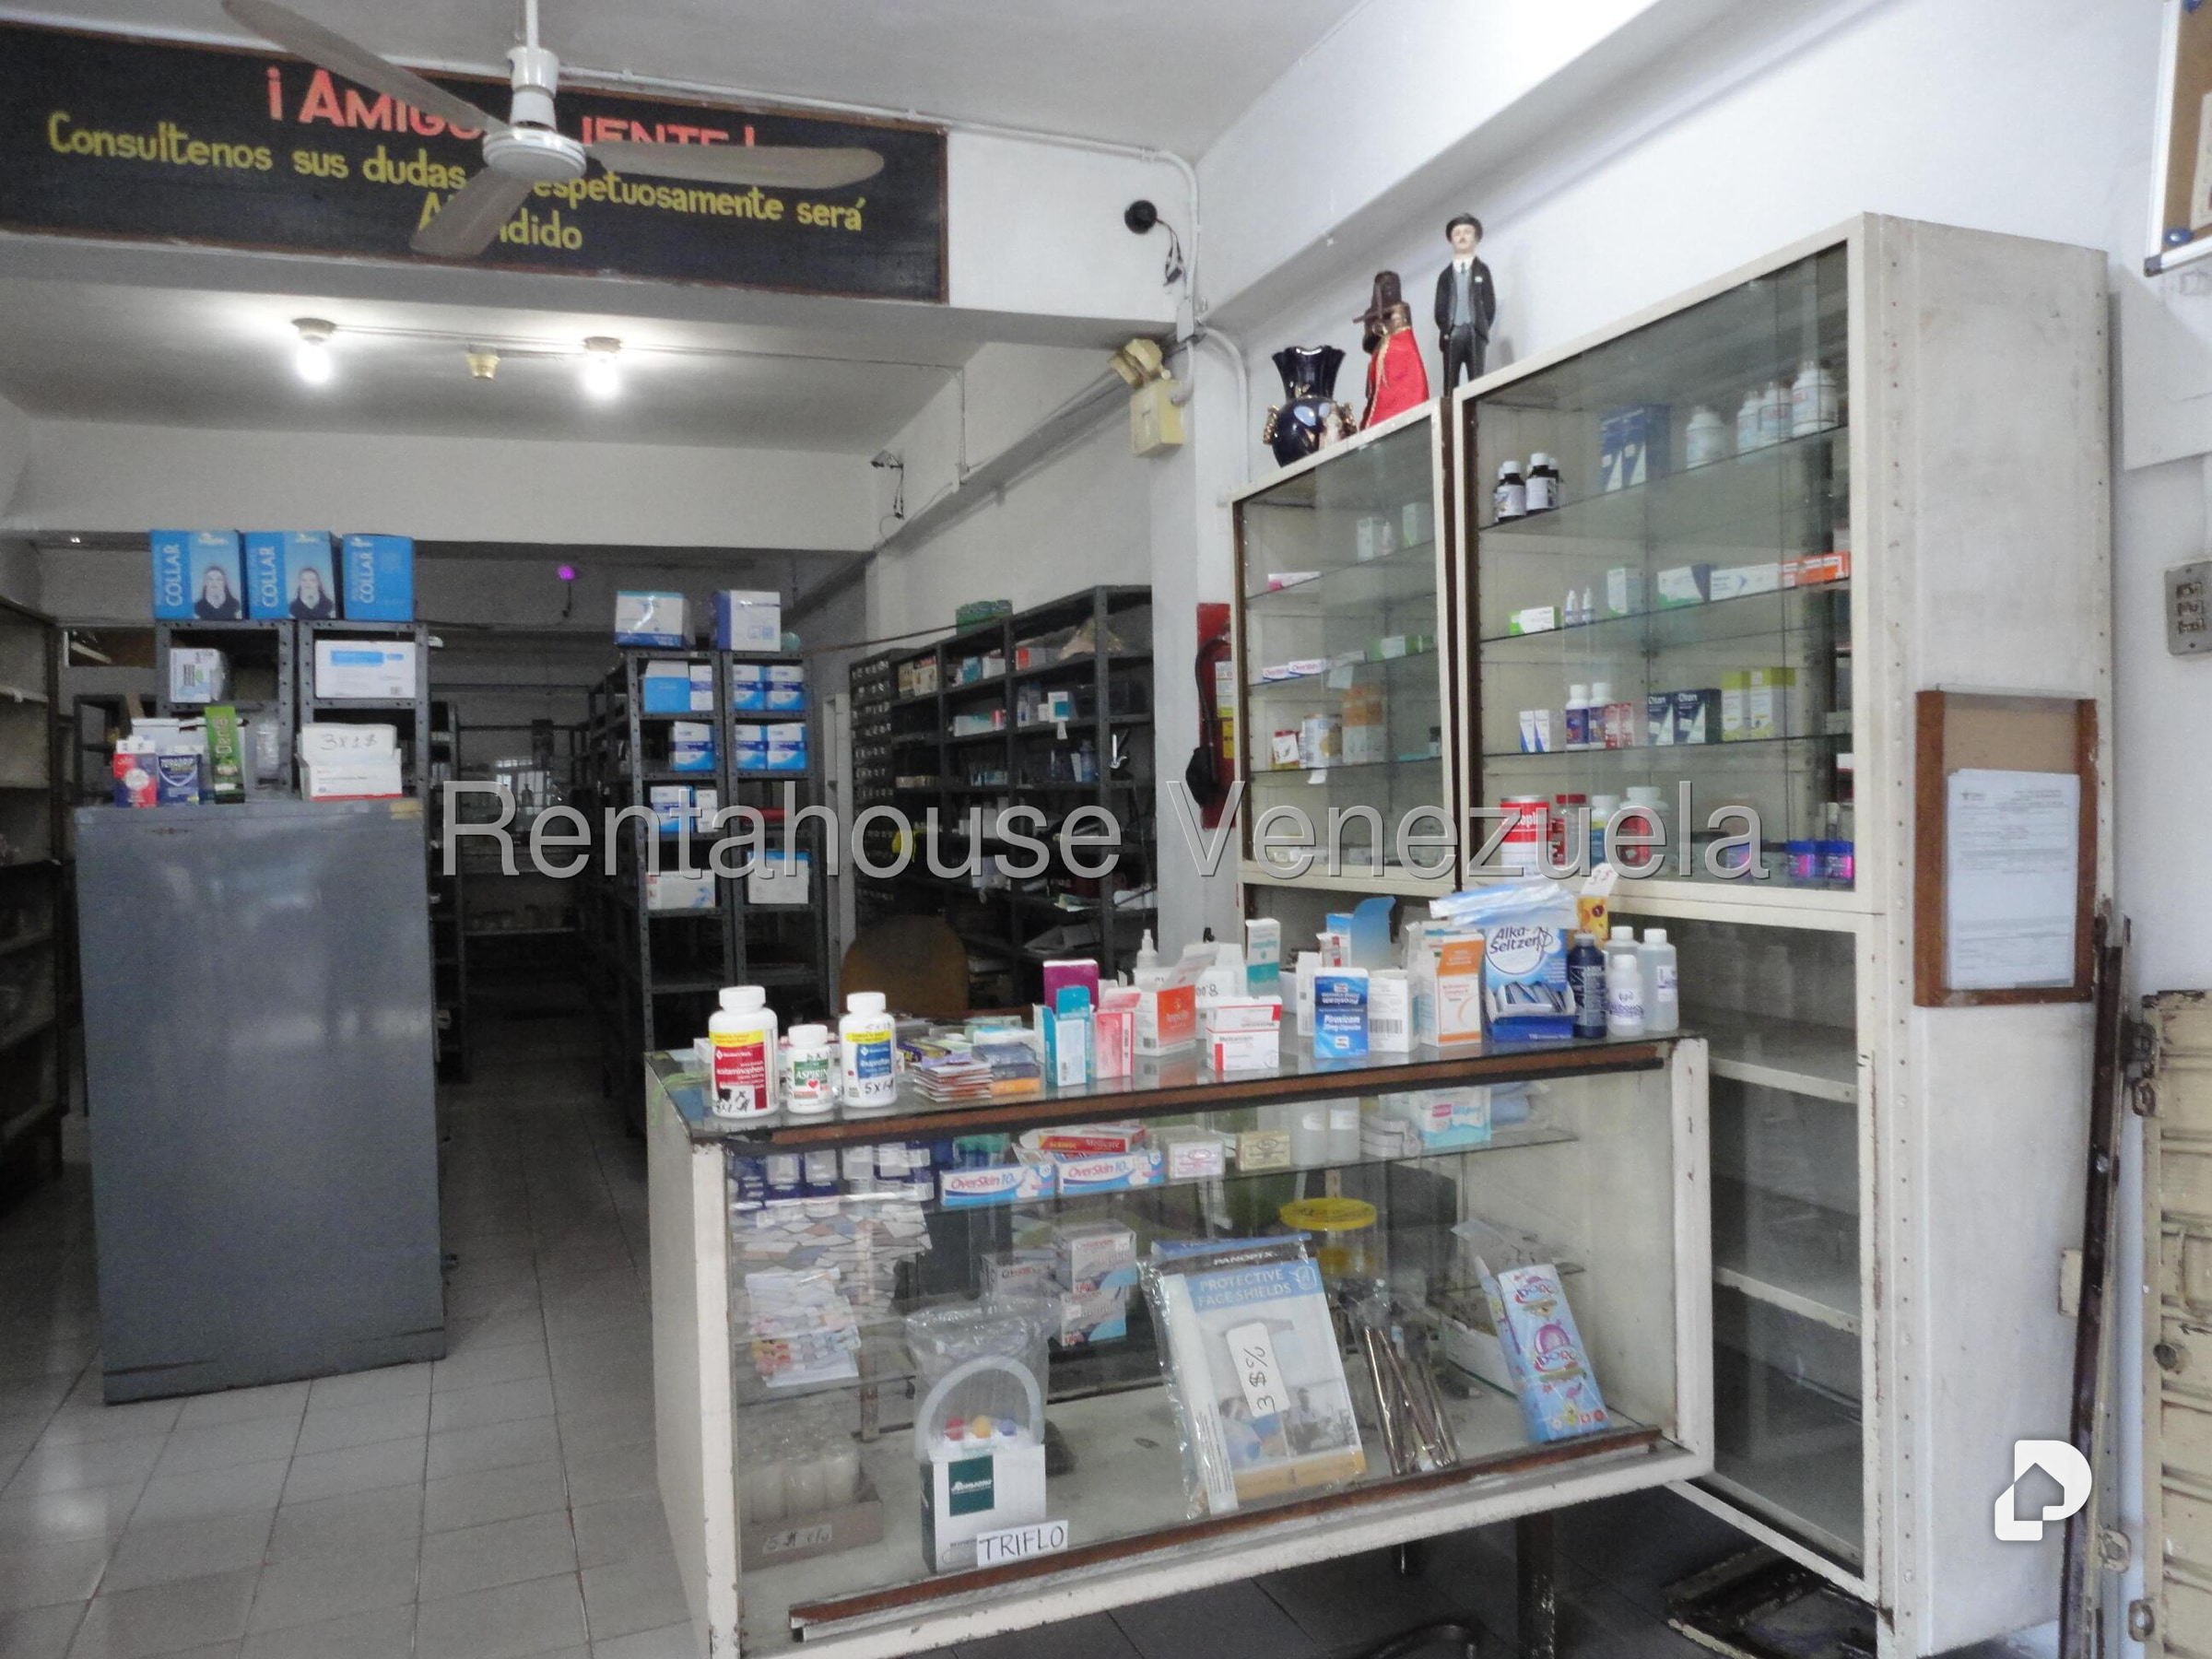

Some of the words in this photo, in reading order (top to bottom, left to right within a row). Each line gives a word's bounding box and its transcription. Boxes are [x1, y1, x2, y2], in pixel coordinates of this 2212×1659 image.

[298, 68, 489, 139] AMIG
[48, 112, 273, 171] Consultenos
[291, 149, 348, 179] sus
[362, 145, 466, 191] dudas
[532, 171, 783, 221] espetuosamente
[796, 196, 867, 230] será
[165, 543, 182, 607] COLLAR
[261, 546, 277, 608] COLLAR
[1198, 1292, 1232, 1308] FACE
[1236, 1282, 1292, 1301] SHIELDS
[1200, 1268, 1284, 1292] PROTECTIVE
[979, 1524, 1065, 1561] TRIFLO
